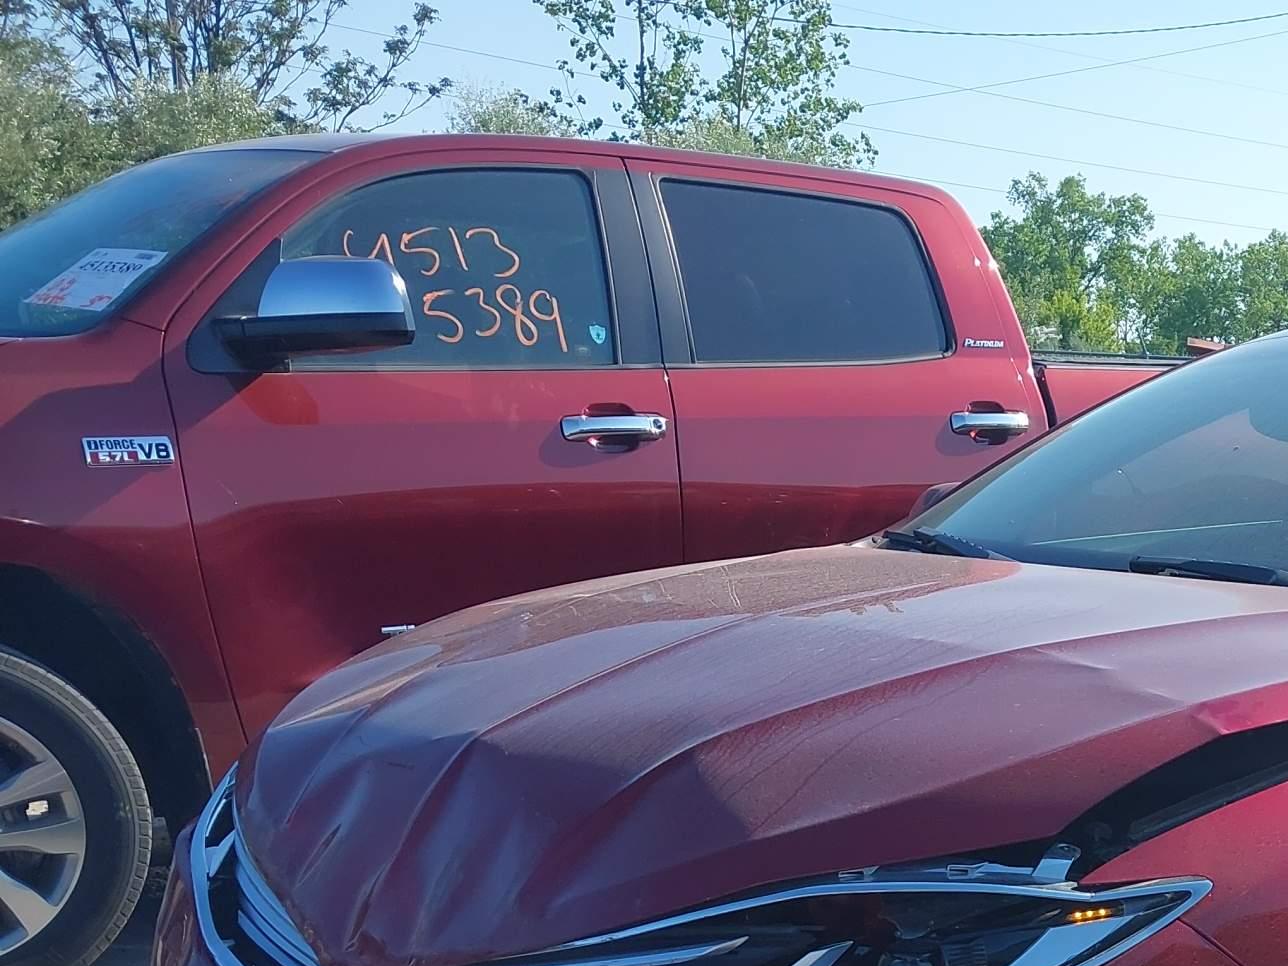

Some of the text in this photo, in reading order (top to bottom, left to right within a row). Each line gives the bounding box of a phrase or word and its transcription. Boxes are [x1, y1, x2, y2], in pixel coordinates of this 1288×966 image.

[423, 284, 568, 353] 5389
[98, 451, 135, 462] 5.7L
[138, 442, 172, 460] V8
